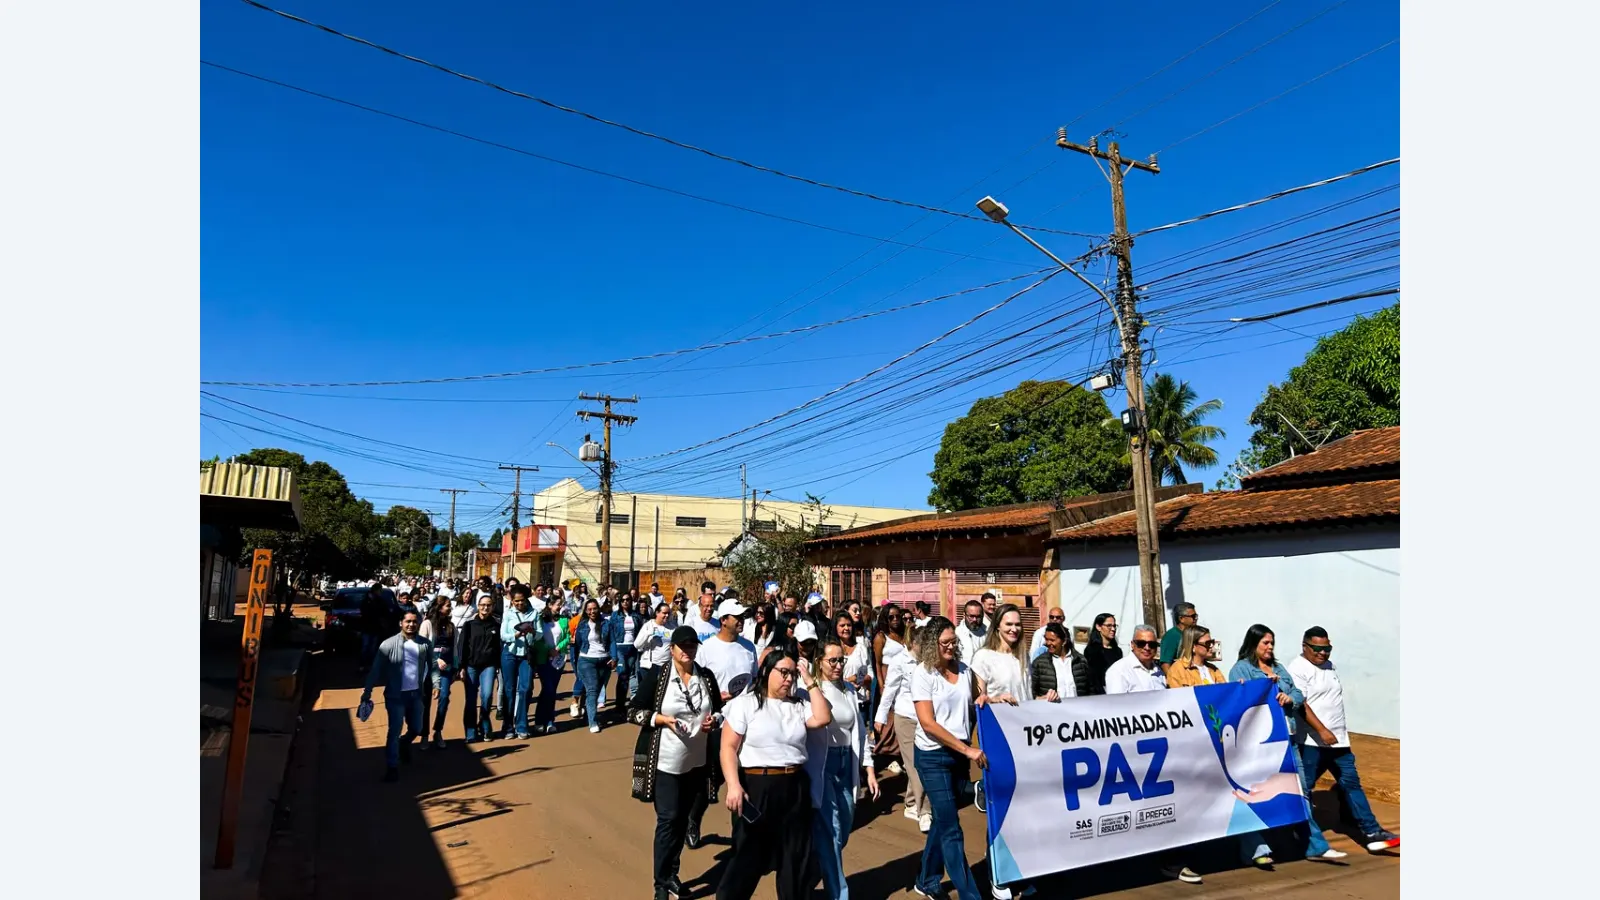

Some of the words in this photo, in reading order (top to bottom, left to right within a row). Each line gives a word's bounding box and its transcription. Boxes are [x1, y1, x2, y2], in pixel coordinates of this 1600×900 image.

[1057, 712, 1168, 743] CAMINHADA
[1167, 710, 1194, 730] DA
[1061, 737, 1175, 811] PAZ
[1145, 807, 1173, 820] PREFCG
[1076, 819, 1093, 830] SAS
[1101, 823, 1129, 834] RESULTADO
